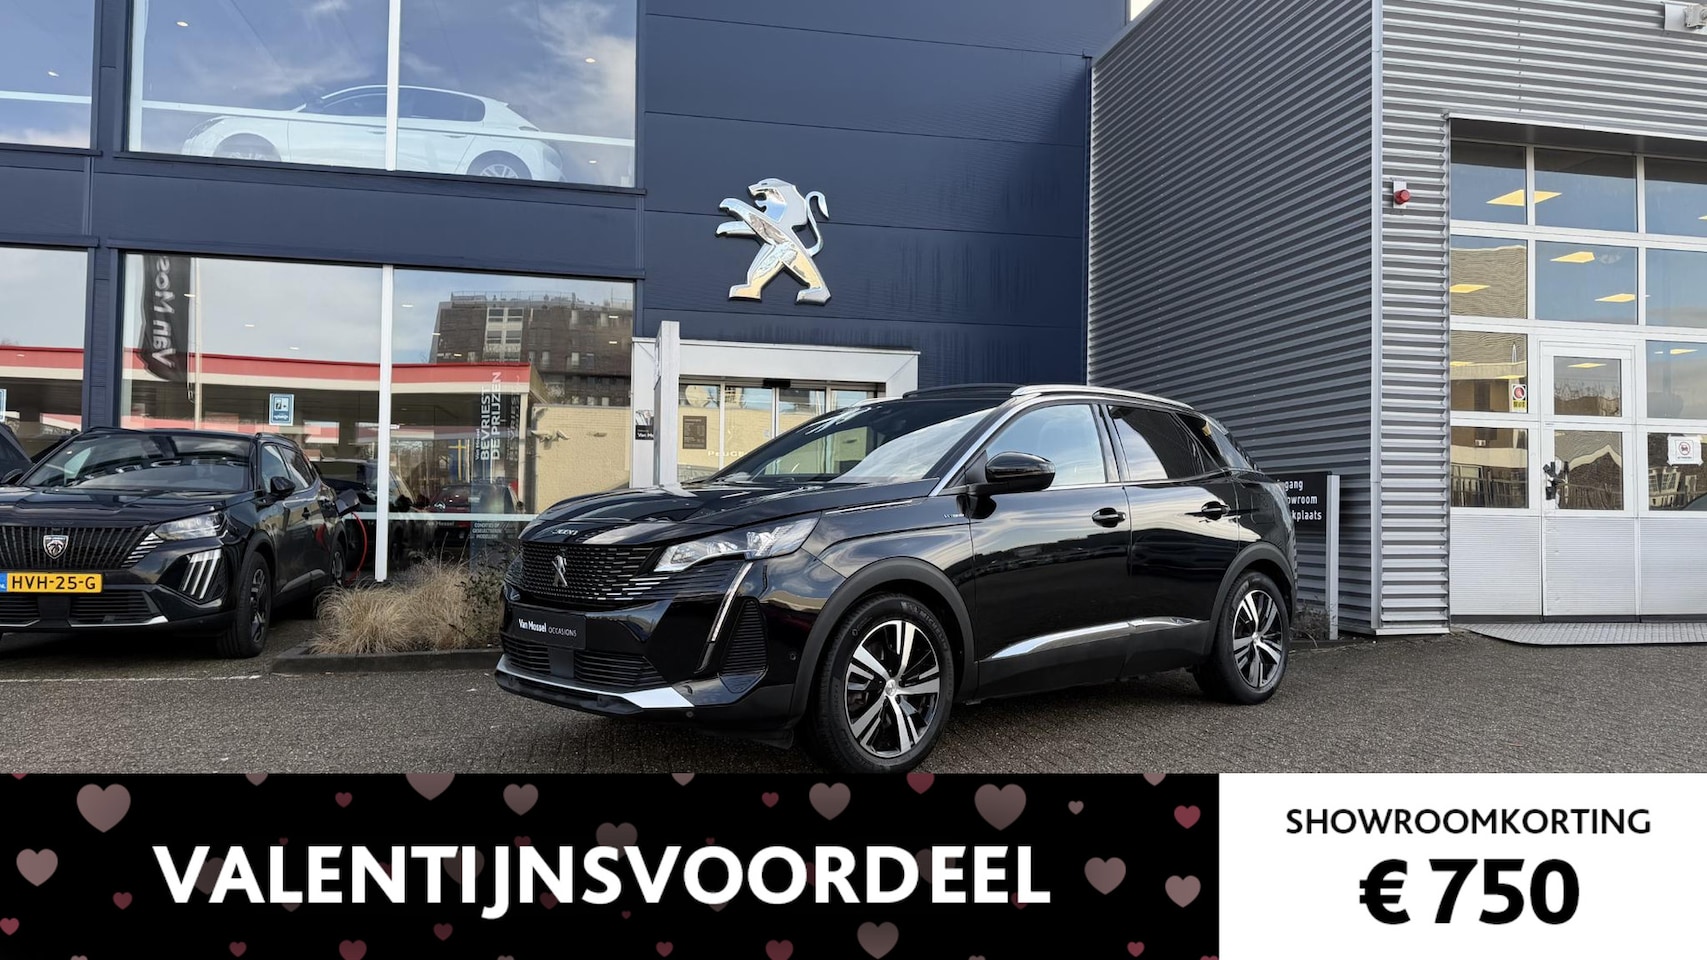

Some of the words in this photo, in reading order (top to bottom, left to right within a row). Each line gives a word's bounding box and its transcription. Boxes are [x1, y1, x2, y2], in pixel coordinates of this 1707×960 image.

[491, 371, 501, 435] PRIJZEN
[480, 386, 491, 460] BEVRIEST
[491, 438, 500, 460] DE
[1284, 481, 1303, 491] gang
[1288, 495, 1317, 504] owroom
[1292, 510, 1322, 522] kplaats
[12, 575, 96, 590] HVH-25-G
[518, 618, 528, 629] Van
[528, 620, 547, 633] Mossel
[547, 626, 577, 637] OCCASIONS
